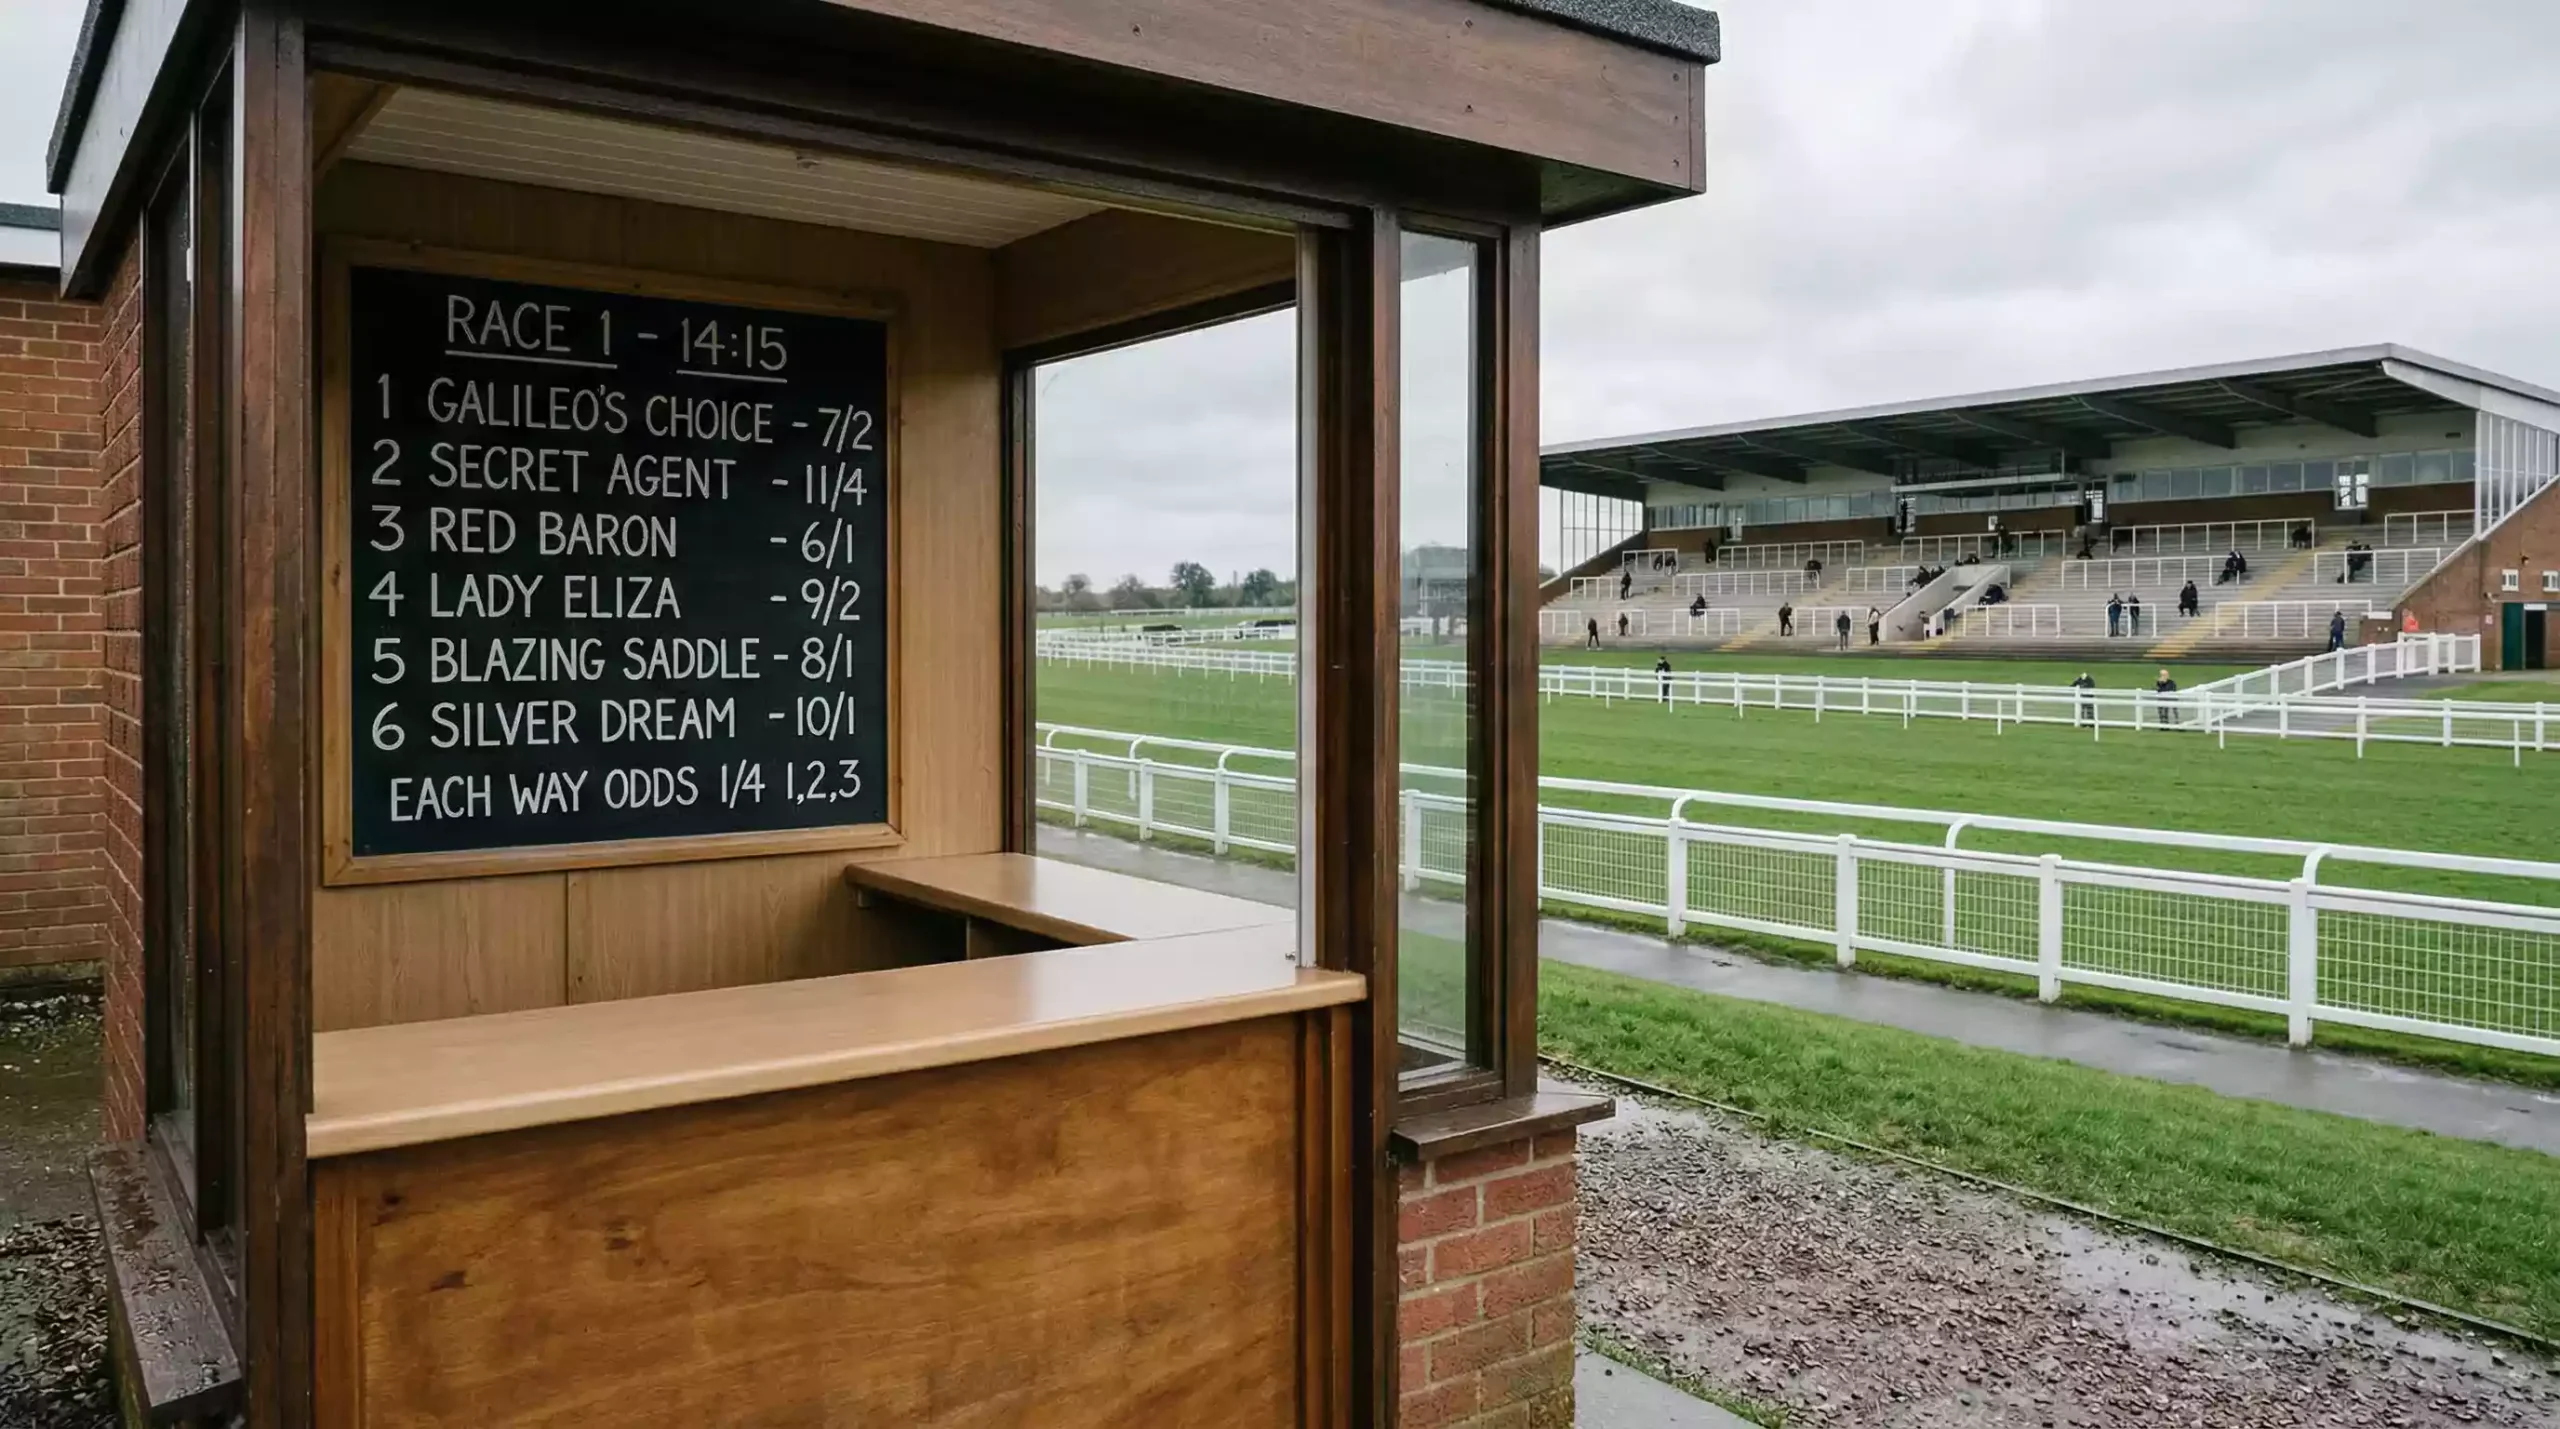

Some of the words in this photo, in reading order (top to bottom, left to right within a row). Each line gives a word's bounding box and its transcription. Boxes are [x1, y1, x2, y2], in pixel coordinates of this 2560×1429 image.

[445, 295, 572, 353] RACE
[600, 309, 613, 356] 1
[637, 332, 659, 340] -
[681, 317, 788, 371] 14:15
[377, 373, 391, 419] 1
[428, 377, 628, 434] GALILEO'S
[646, 395, 773, 444] CHOICE
[371, 438, 401, 486] 2
[428, 442, 589, 493] SECRET
[607, 453, 737, 500] AGENT
[370, 505, 405, 552] 3
[430, 507, 516, 554] RED
[539, 511, 677, 558] BARON
[368, 570, 405, 617] 4
[431, 572, 544, 618] LADY
[564, 575, 682, 619] ELIZA
[371, 637, 406, 685] 5
[431, 637, 606, 684] BLAZING
[622, 637, 761, 681] SADDLE
[371, 701, 405, 751] 6
[430, 699, 580, 749] SILVER
[601, 697, 735, 743] DREAM
[390, 774, 492, 822] EACH
[509, 769, 589, 816] WAY
[603, 765, 699, 809] ODDS
[721, 758, 766, 809] 1/4
[787, 759, 861, 805] 1,2,3
